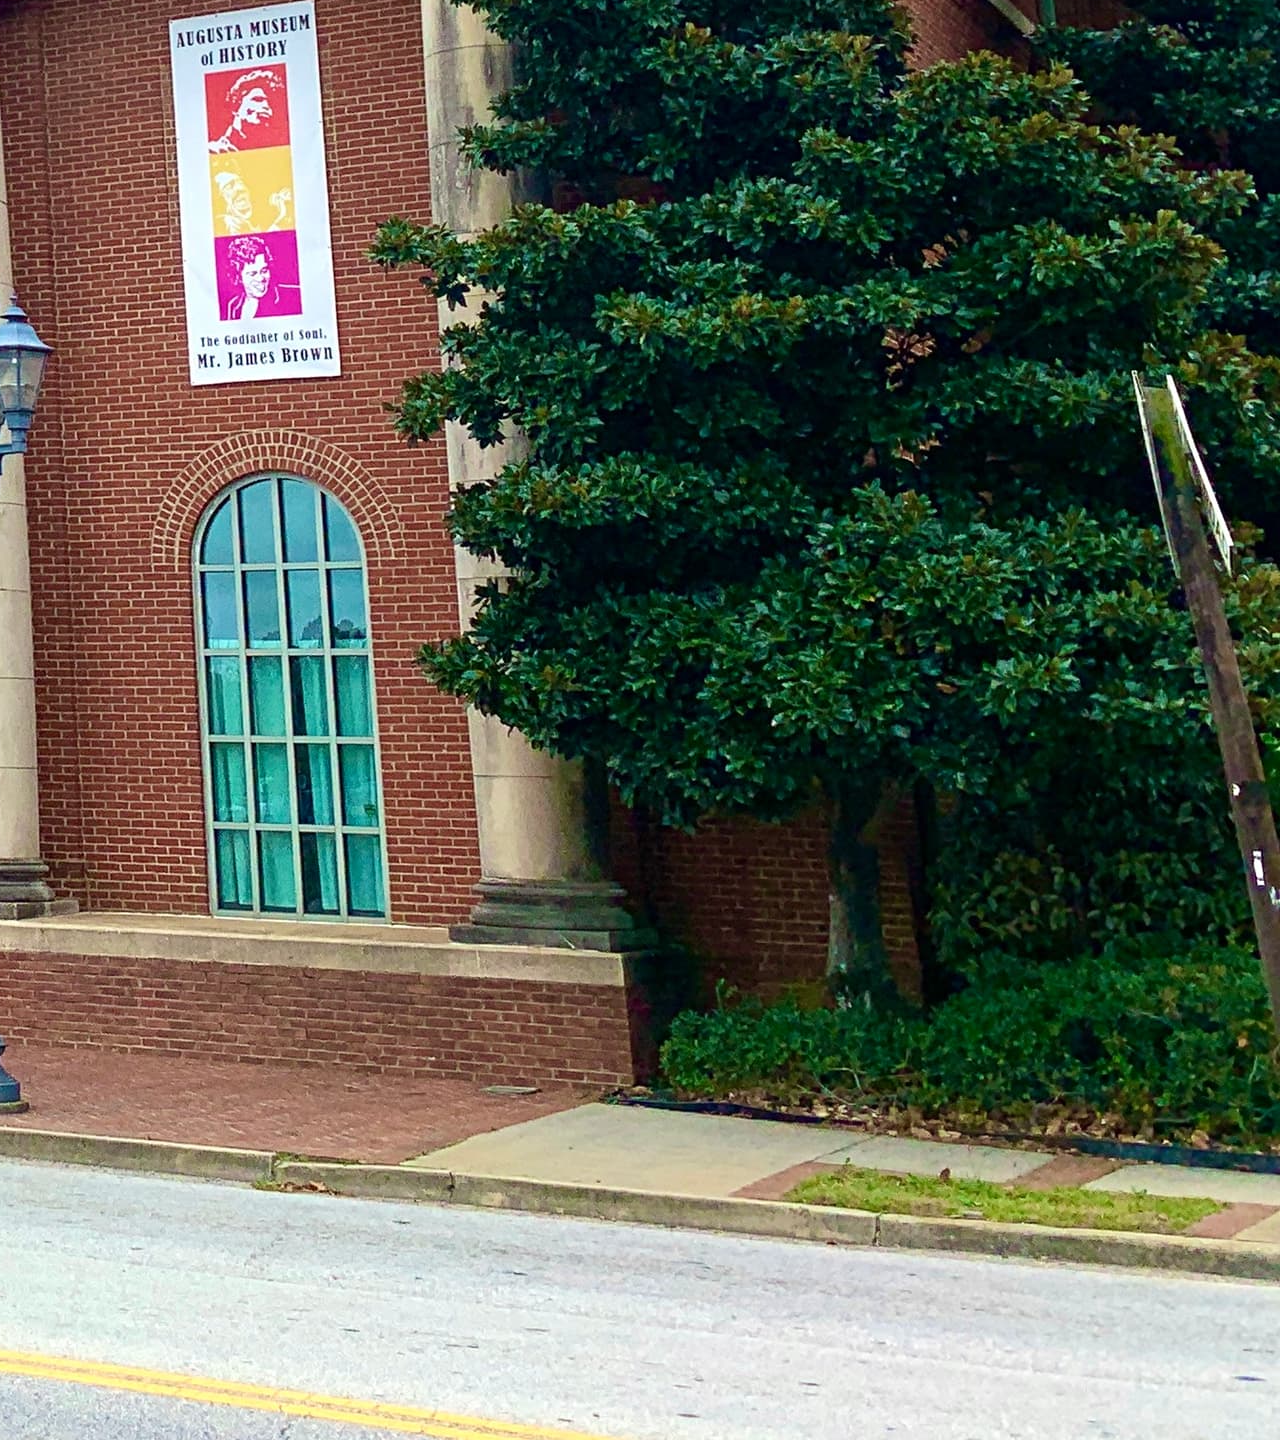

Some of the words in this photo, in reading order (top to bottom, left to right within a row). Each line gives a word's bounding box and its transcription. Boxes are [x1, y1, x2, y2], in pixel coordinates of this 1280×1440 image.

[177, 24, 243, 48] AUGUSTA
[250, 14, 310, 37] MUSEUM
[201, 50, 214, 66] of
[219, 40, 287, 63] HISTORY
[200, 336, 220, 347] The
[224, 332, 278, 346] Godfather
[283, 330, 294, 341] of
[197, 353, 220, 369] Mr.
[228, 350, 275, 369] James
[281, 346, 333, 363] Brown
